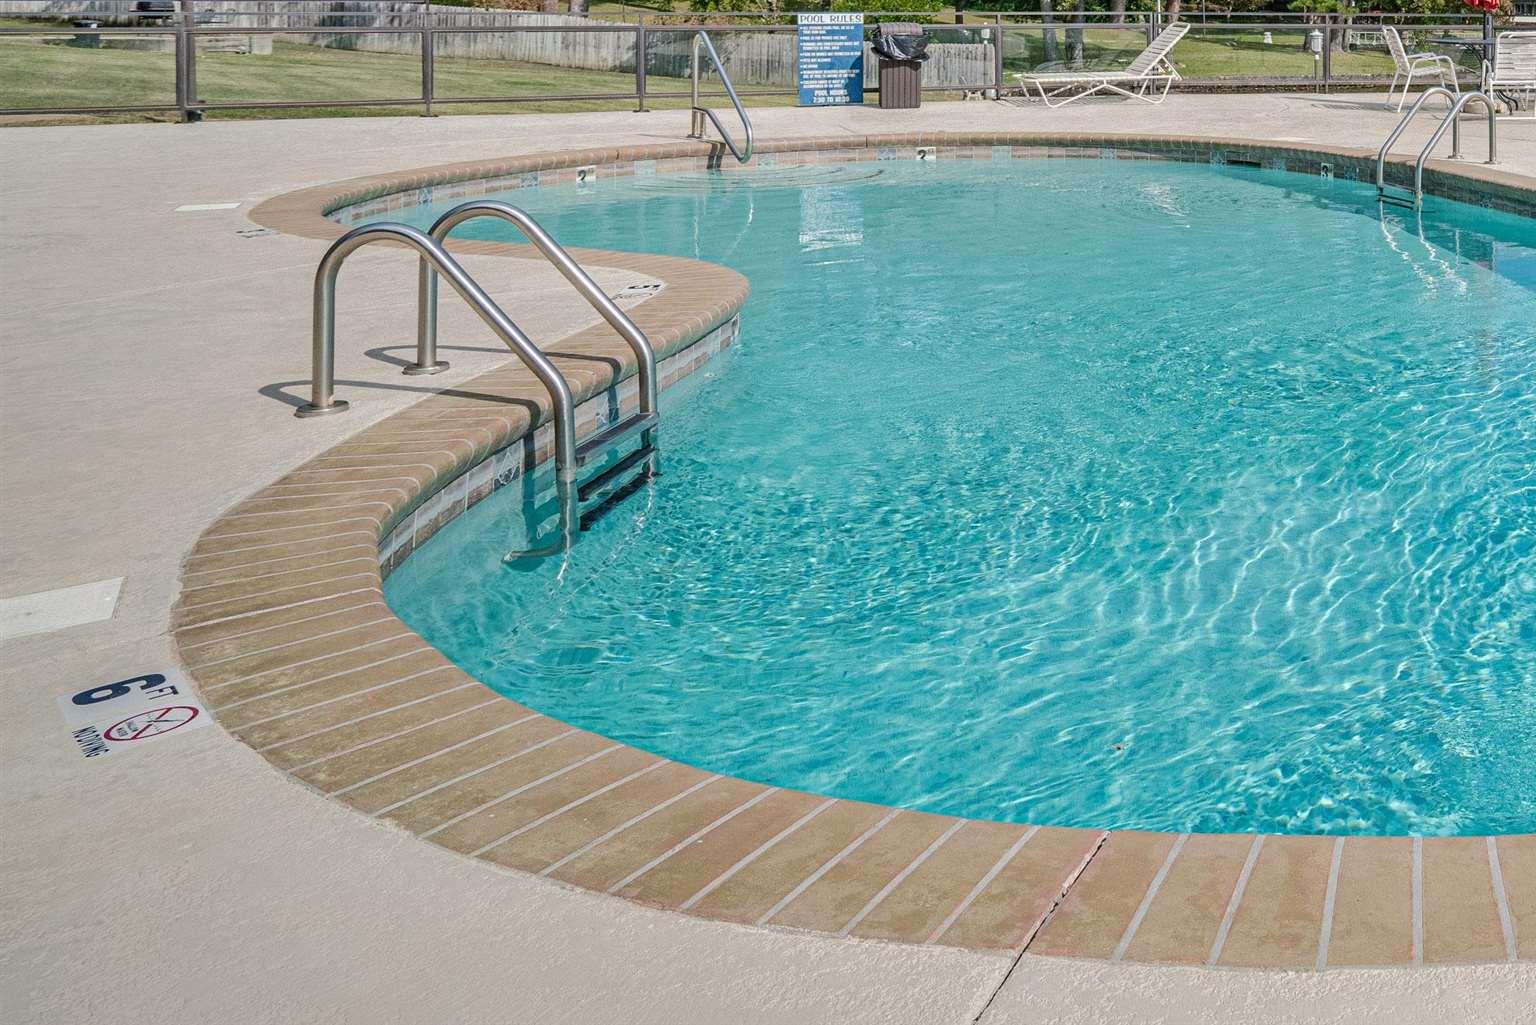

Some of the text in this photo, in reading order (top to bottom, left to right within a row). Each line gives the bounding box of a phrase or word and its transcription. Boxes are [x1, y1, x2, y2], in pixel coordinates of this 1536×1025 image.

[800, 14, 862, 23] POOL RULES
[71, 673, 179, 705] 6 FT
[72, 725, 97, 739] NO
